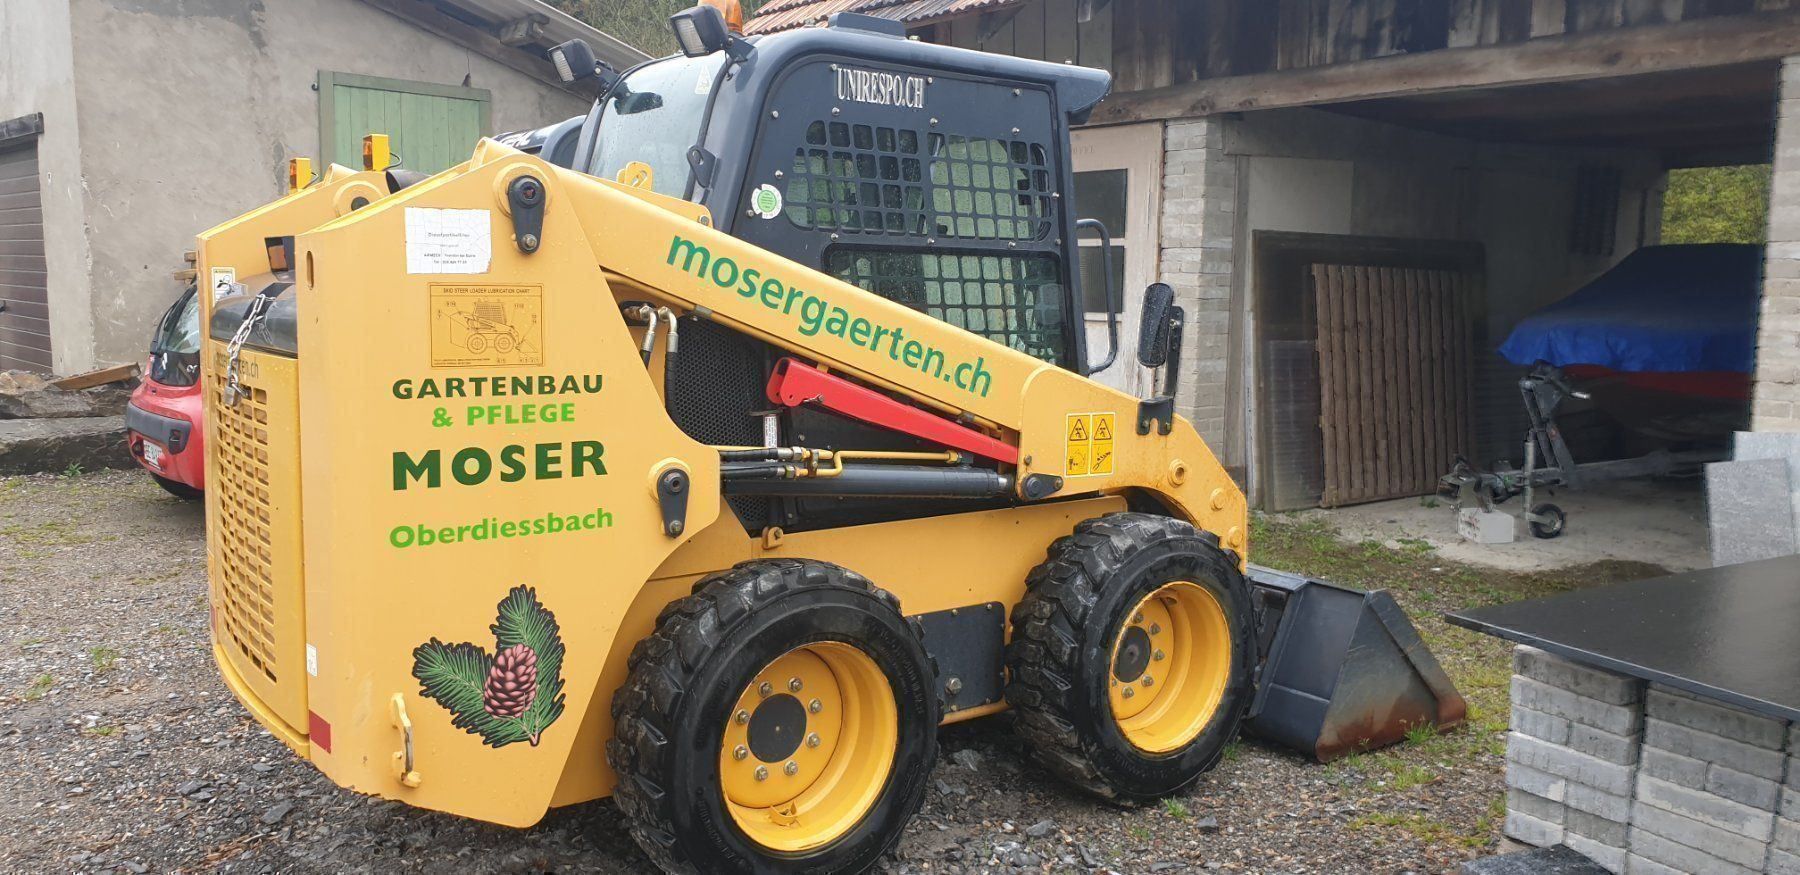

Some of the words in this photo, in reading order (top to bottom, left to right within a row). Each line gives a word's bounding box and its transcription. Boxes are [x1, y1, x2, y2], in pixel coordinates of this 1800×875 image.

[837, 67, 924, 109] UNIRESPO.CH
[487, 287, 515, 295] LUBRICATION
[666, 235, 992, 398] mosergaerten.ch
[392, 374, 604, 400] GARTENBAU
[431, 406, 454, 428] &
[466, 402, 576, 426] PFLEGE
[392, 440, 608, 491] MOSER
[389, 507, 614, 549] Oberdiessbach
